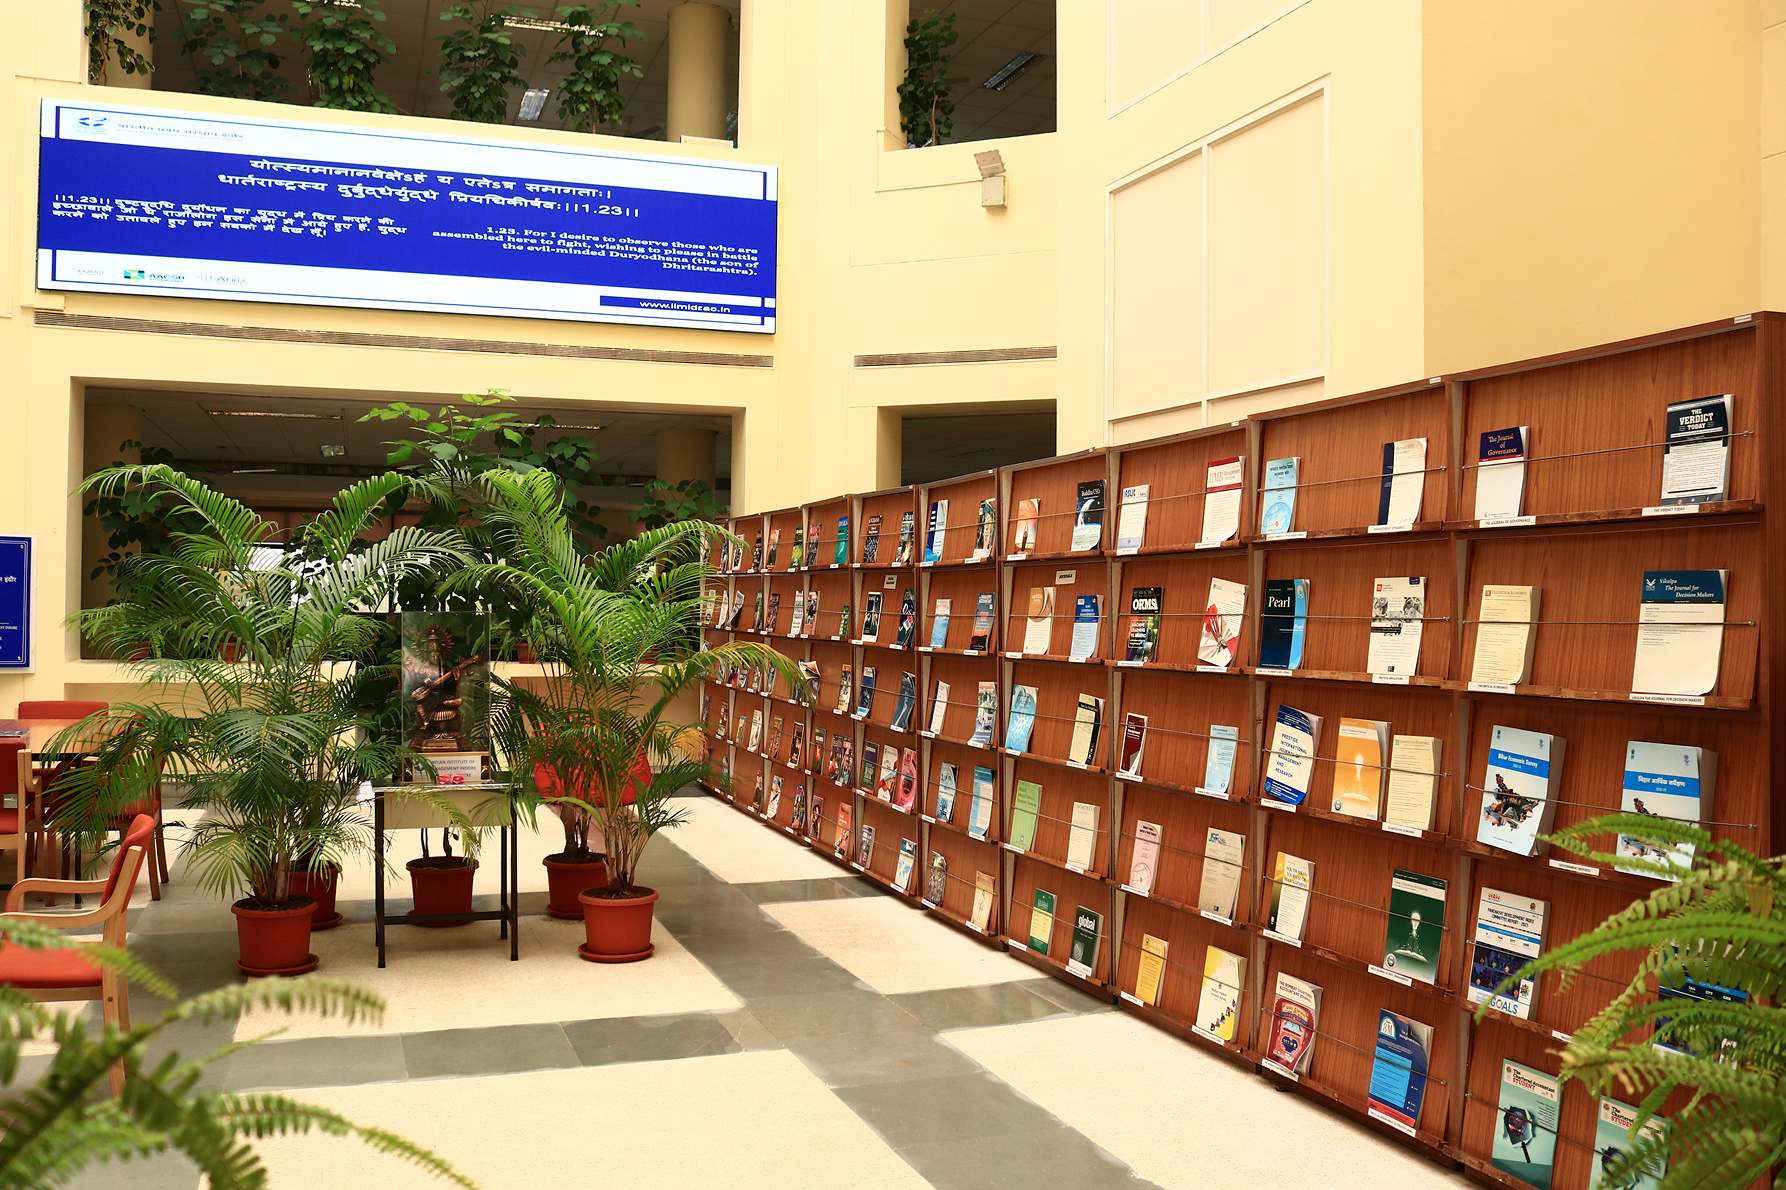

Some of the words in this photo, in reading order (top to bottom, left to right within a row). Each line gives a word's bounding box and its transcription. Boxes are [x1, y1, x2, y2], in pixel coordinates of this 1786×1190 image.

[436, 175, 454, 185] य
[92, 212, 110, 220] को
[194, 220, 214, 228] इन
[234, 207, 251, 215] का
[378, 216, 394, 226] की
[378, 225, 408, 235] युद्ध
[486, 226, 520, 236] 1.23.
[524, 228, 548, 237] For
[559, 232, 600, 242] desire
[618, 237, 668, 248] observe
[671, 241, 706, 250] those
[708, 244, 736, 252] who
[432, 231, 504, 242] assembled
[507, 236, 538, 244] here
[540, 238, 554, 246] to
[556, 240, 592, 249] fight,
[594, 242, 646, 254] wishing
[664, 248, 704, 258] please
[722, 252, 758, 262] battle
[502, 242, 524, 250] the
[526, 245, 606, 257] evil-minded
[609, 250, 689, 264] Duryodhana
[691, 257, 718, 266] (the
[662, 262, 758, 276] Dhritarashtra).
[1679, 412, 1714, 426] VERDICT
[1686, 422, 1706, 430] TODAY
[1497, 433, 1514, 443] Journal
[1487, 448, 1517, 456] Governance
[1132, 598, 1158, 610] ORMS
[1268, 596, 1291, 608] Pearl
[1282, 733, 1298, 744] PRESTIGE
[1280, 740, 1308, 755] INTERNATIONAL
[1278, 754, 1302, 766] MANAGEMENT
[1275, 767, 1293, 778] RESEARCH
[1078, 914, 1096, 931] global
[1490, 997, 1518, 1015] GOALS
[1513, 1074, 1532, 1084] Chartered
[1533, 1081, 1555, 1093] Accountant
[1513, 1078, 1535, 1090] STUDENT
[1611, 1112, 1634, 1123] Chartered
